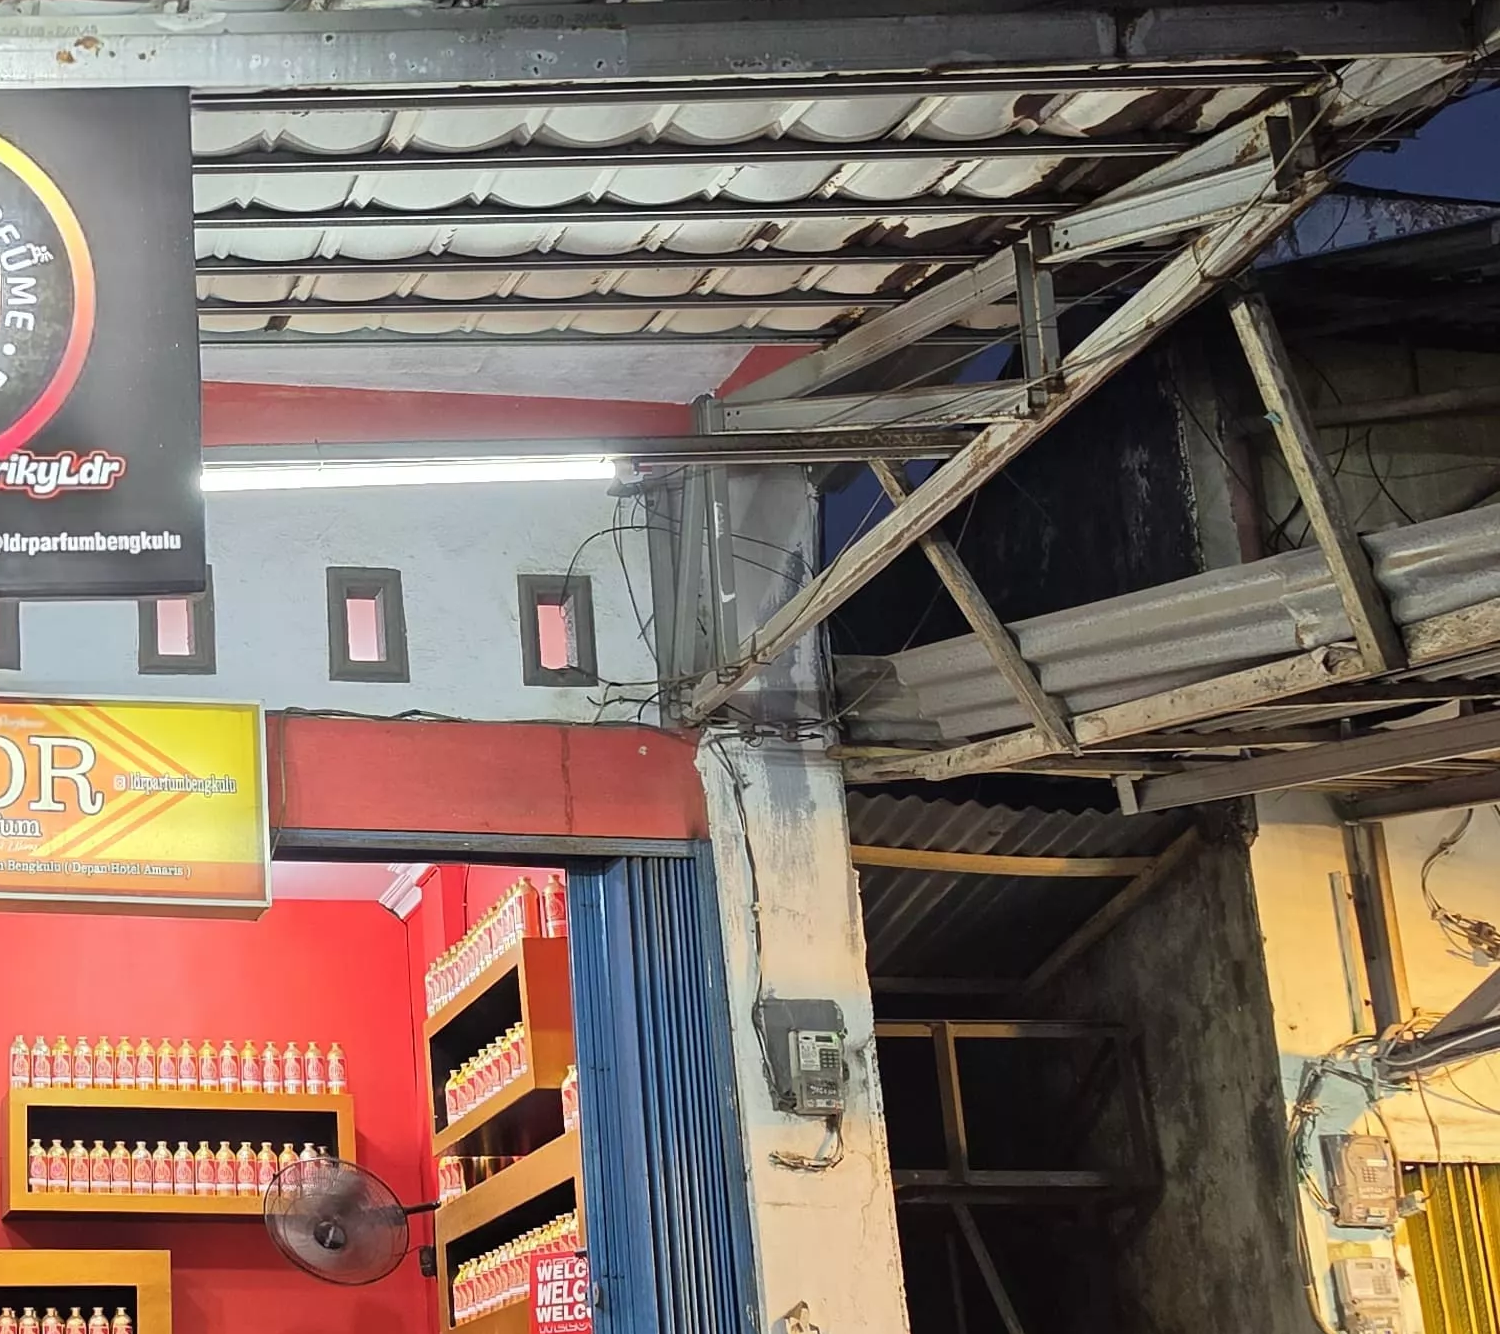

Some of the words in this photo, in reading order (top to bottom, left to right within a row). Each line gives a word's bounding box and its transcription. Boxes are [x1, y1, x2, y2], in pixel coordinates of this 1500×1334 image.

[130, 772, 237, 798] ldrparfumbengkulu
[7, 859, 61, 875] Bengkulu
[111, 863, 141, 875] Hotel
[536, 1260, 589, 1283] WELC
[537, 1279, 588, 1306] WELC
